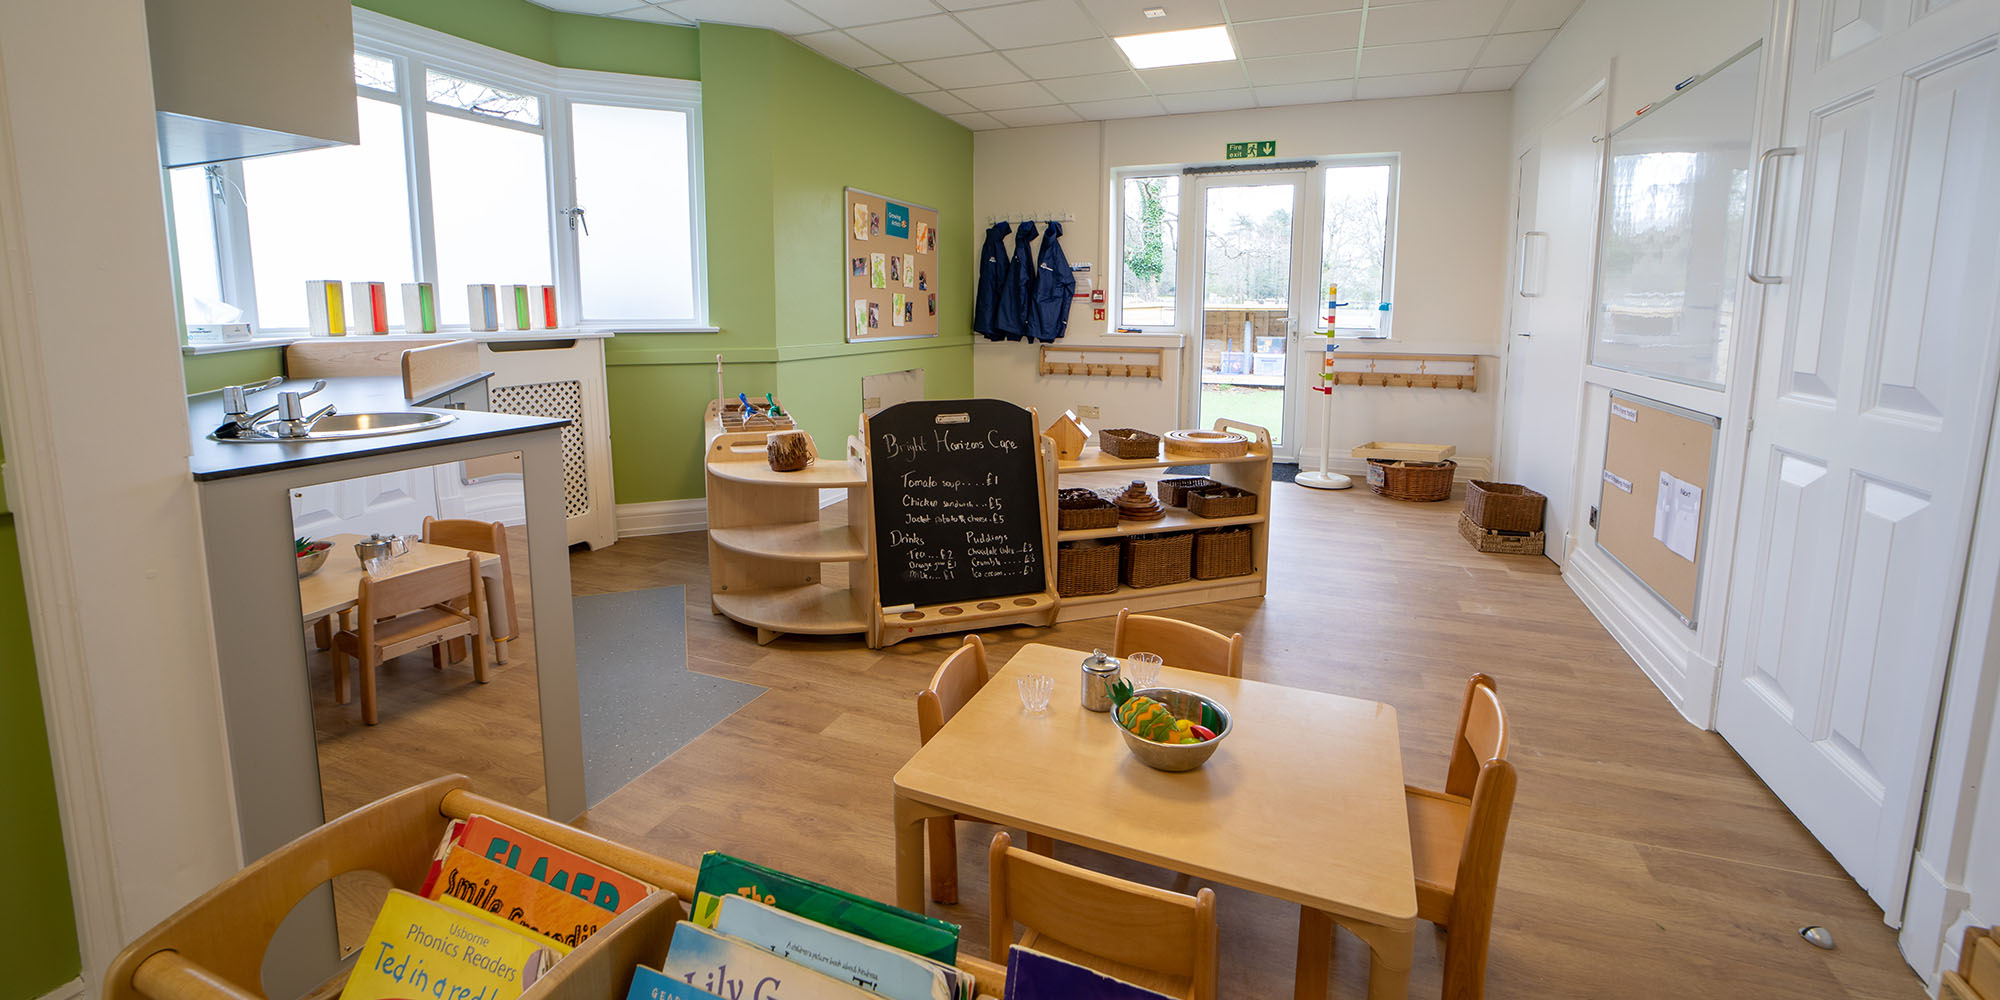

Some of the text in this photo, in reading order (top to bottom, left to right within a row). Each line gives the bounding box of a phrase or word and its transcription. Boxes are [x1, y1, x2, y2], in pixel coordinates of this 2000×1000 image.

[883, 433, 927, 462] Bright
[900, 470, 938, 488] Tomato
[903, 494, 938, 507] Chicken
[1680, 487, 1692, 498] Next
[905, 513, 931, 524] Jacket
[890, 529, 925, 547] Drinks
[965, 530, 1008, 544] Puddings
[443, 867, 505, 914] Smile
[737, 885, 777, 905] The
[450, 922, 490, 948] Usborne
[406, 923, 518, 983] Phonics Readers
[374, 941, 411, 984] Ted
[408, 959, 428, 992] in
[432, 977, 448, 999] a
